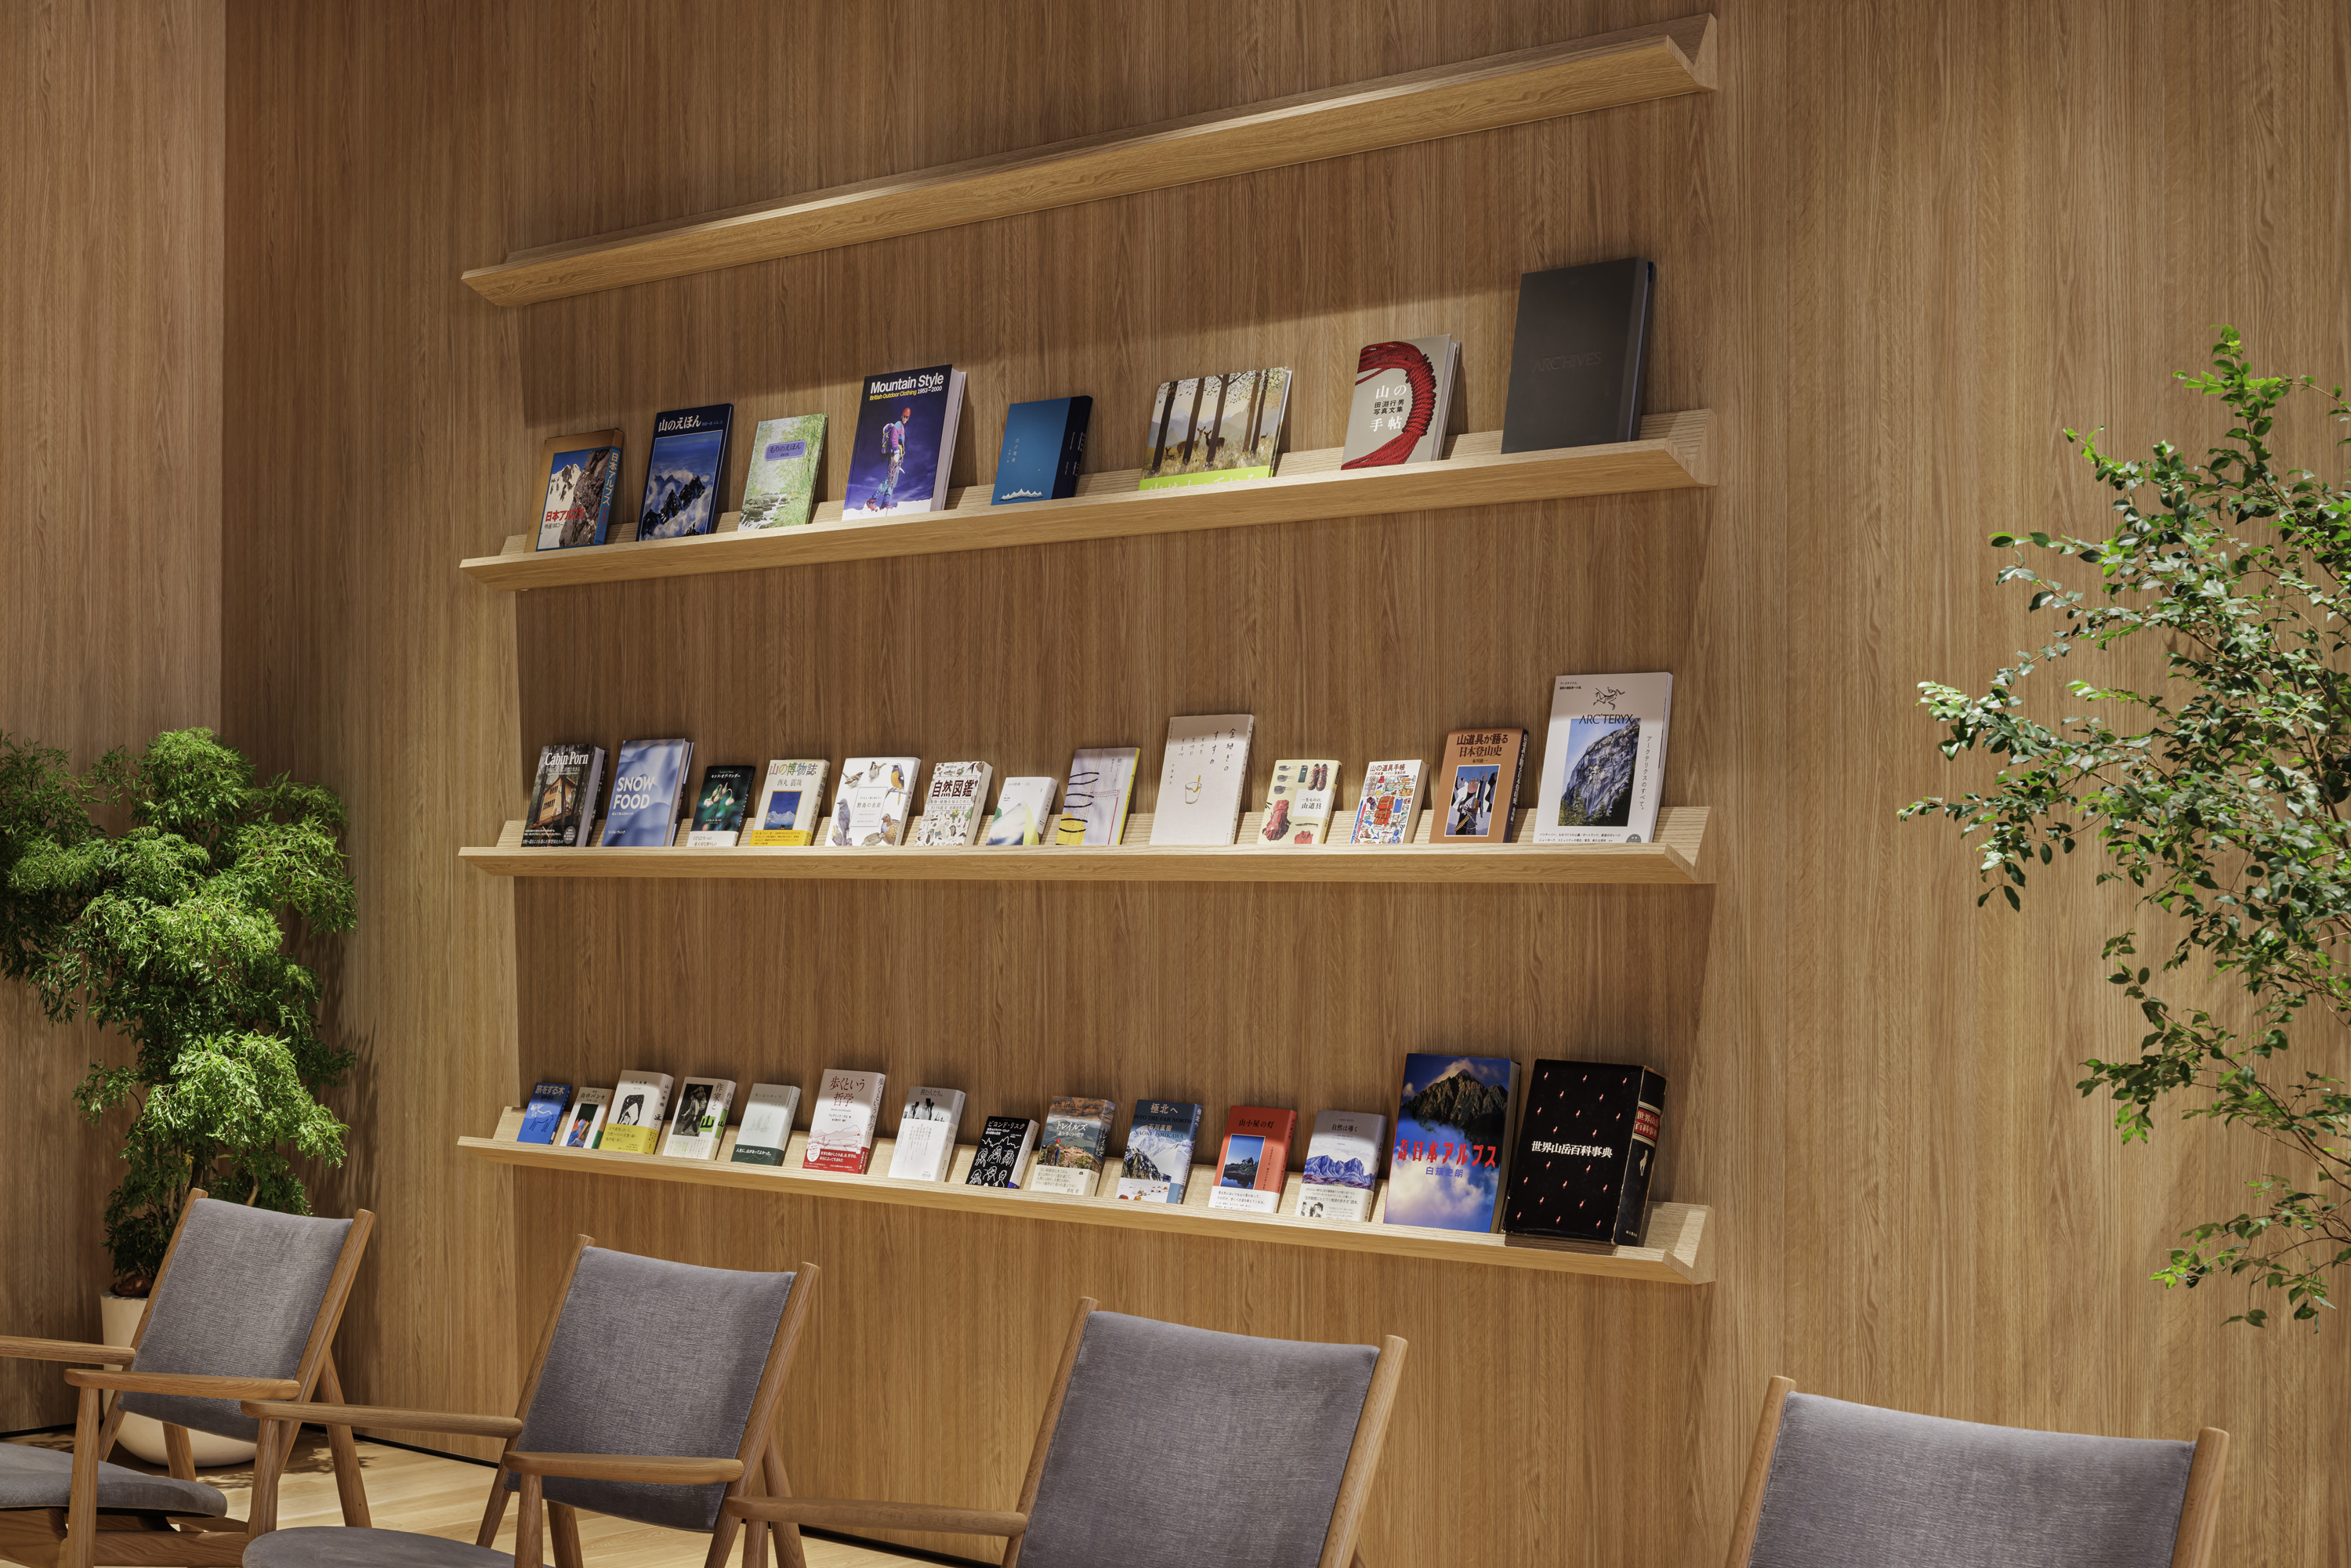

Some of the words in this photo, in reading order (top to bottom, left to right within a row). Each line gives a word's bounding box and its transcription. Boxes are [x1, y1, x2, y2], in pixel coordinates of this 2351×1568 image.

[1532, 351, 1603, 372] ARCHIVES
[870, 376, 916, 394] Mountain
[918, 372, 944, 389] Style
[1375, 385, 1407, 400] 山の
[1373, 407, 1404, 415] 写真文集
[658, 415, 701, 432] 山のえほん
[1370, 415, 1403, 432] 手帖
[770, 444, 802, 453] もりのえほん
[602, 452, 619, 506] 日本アルプス
[545, 508, 585, 522] 日本アルプス
[1456, 733, 1509, 745] 山道具が語る
[1459, 744, 1502, 757] 日本登山史
[545, 752, 569, 766] Cabin
[568, 751, 589, 765] Porn
[769, 762, 817, 776] 山の博物誌
[616, 776, 655, 792] SNOW
[932, 780, 974, 798] 自然図鑑
[613, 794, 650, 809] FOOD
[535, 1085, 566, 1095] 旅をする木
[829, 1076, 865, 1092] 歩くという
[834, 1092, 853, 1107] 哲学
[1150, 1103, 1179, 1114] 極北へ
[700, 1114, 715, 1128] 山
[987, 1121, 1026, 1130] ビヨンド・リスク
[1056, 1121, 1089, 1132] トレイルズ
[1148, 1123, 1172, 1132] 石川直樹
[1239, 1119, 1275, 1129] 山小屋の灯
[1332, 1124, 1358, 1132] 自然は導く
[1411, 1140, 1497, 1169] 日本アルプス
[1531, 1140, 1613, 1159] 世界山岳百科事典
